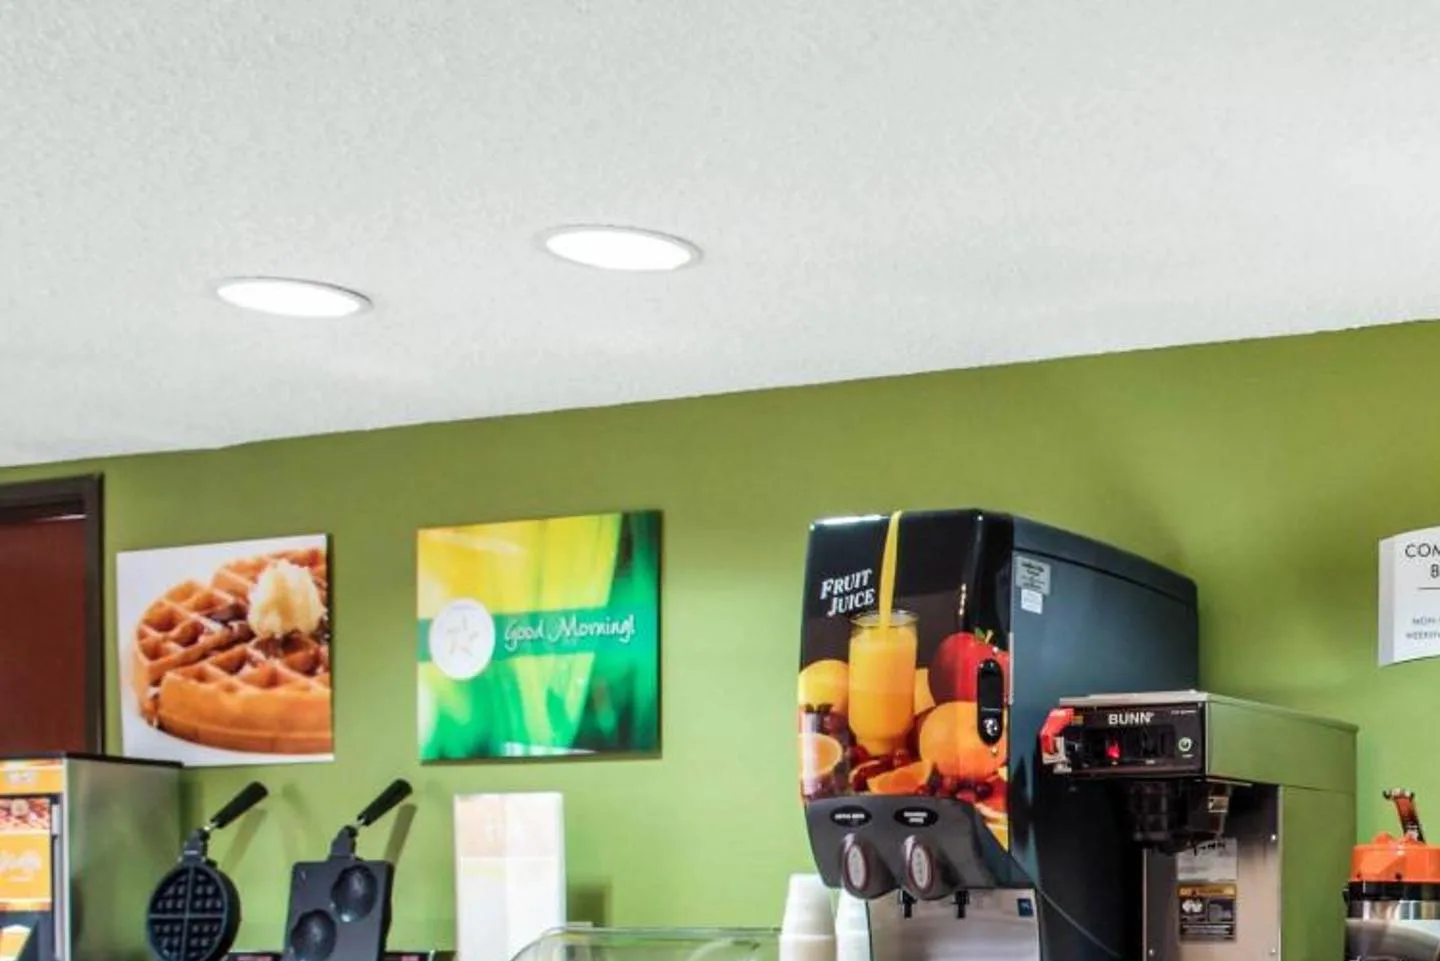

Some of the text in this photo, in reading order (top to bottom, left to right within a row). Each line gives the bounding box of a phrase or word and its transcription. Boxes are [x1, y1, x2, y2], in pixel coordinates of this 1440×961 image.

[820, 567, 873, 600] FRUIT
[826, 588, 876, 617] JUICE
[504, 612, 636, 652] Good Morning!
[1108, 711, 1152, 725] BUNN
